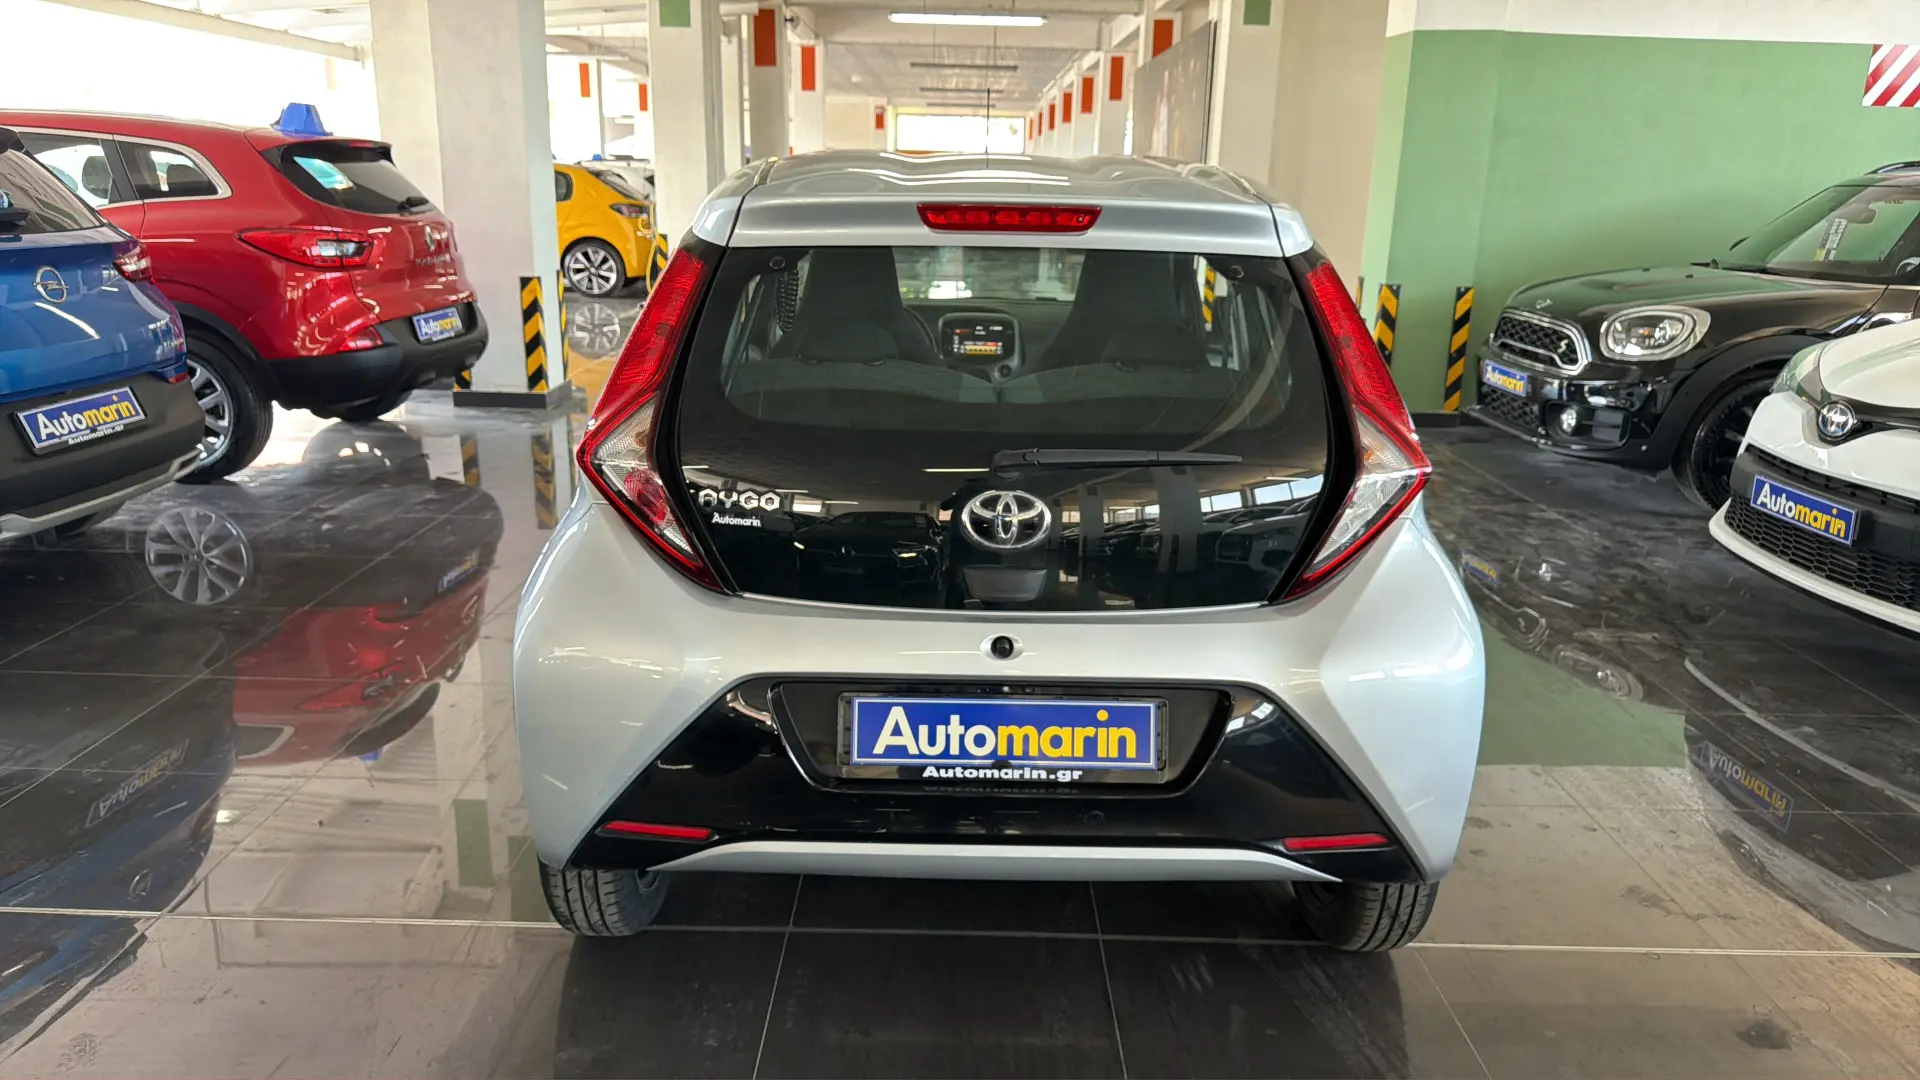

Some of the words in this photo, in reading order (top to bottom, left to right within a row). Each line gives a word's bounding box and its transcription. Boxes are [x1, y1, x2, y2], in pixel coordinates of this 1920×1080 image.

[36, 394, 136, 440] Automarin
[698, 488, 781, 512] AYGO
[1756, 482, 1846, 538] Automarin
[712, 511, 762, 527] Automarin
[873, 706, 1137, 759] Automarin
[922, 765, 1084, 783] Automarin.gr
